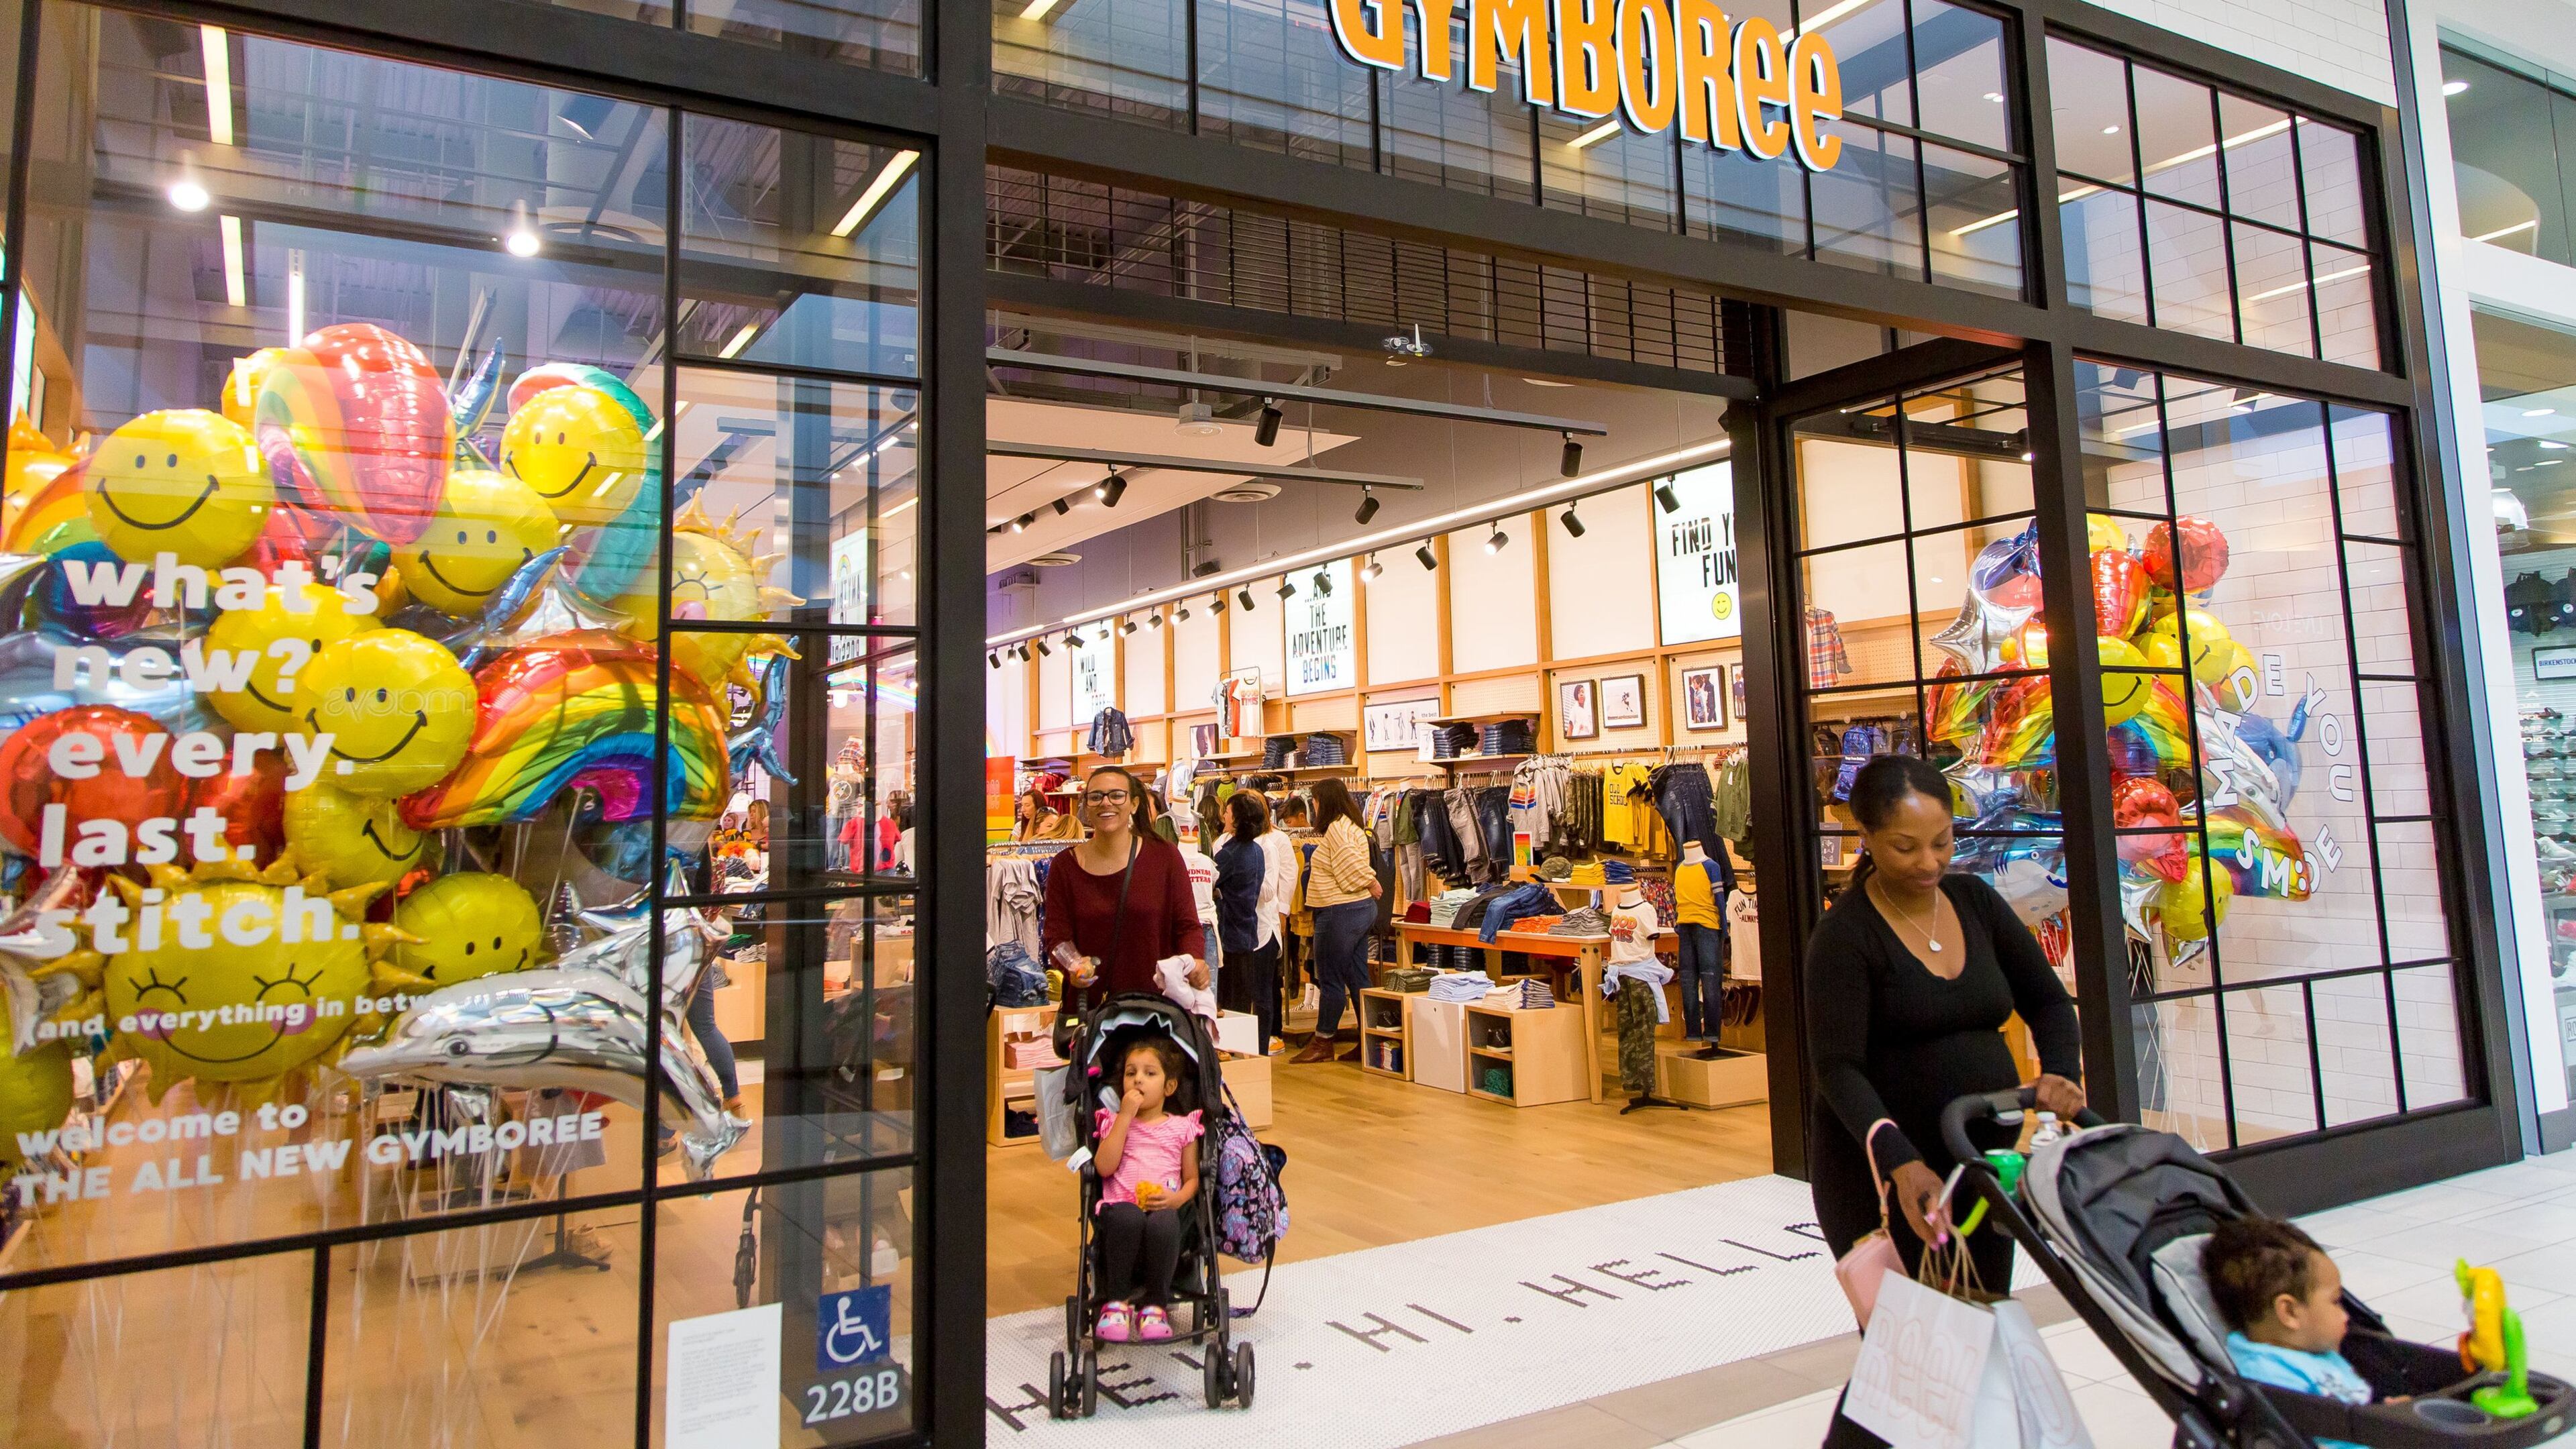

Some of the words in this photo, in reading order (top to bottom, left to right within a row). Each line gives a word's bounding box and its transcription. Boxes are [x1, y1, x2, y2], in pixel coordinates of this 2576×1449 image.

[1672, 517, 1712, 556] FIND
[62, 552, 380, 615] what's
[1703, 549, 1737, 588] FUN
[1309, 603, 1326, 629] THE
[1293, 625, 1348, 659] ADVENTURE
[53, 638, 313, 694] new?
[1303, 654, 1337, 684] BEGINS
[48, 732, 355, 792] every.
[40, 804, 257, 867] last.
[36, 885, 360, 958] stitch.
[1611, 914, 1638, 930] OOD
[1734, 898, 1747, 916] FUN
[1611, 928, 1634, 943] MES
[119, 1000, 309, 1032] everything
[316, 998, 343, 1018] in
[354, 992, 433, 1015] betw
[16, 1110, 240, 1157] welcome
[258, 1102, 309, 1131] to
[12, 1166, 113, 1208] THE
[131, 1155, 224, 1193] ALL
[240, 1139, 353, 1181] NEW
[367, 1111, 605, 1165] GYMBOREE
[805, 1368, 900, 1424] 228B
